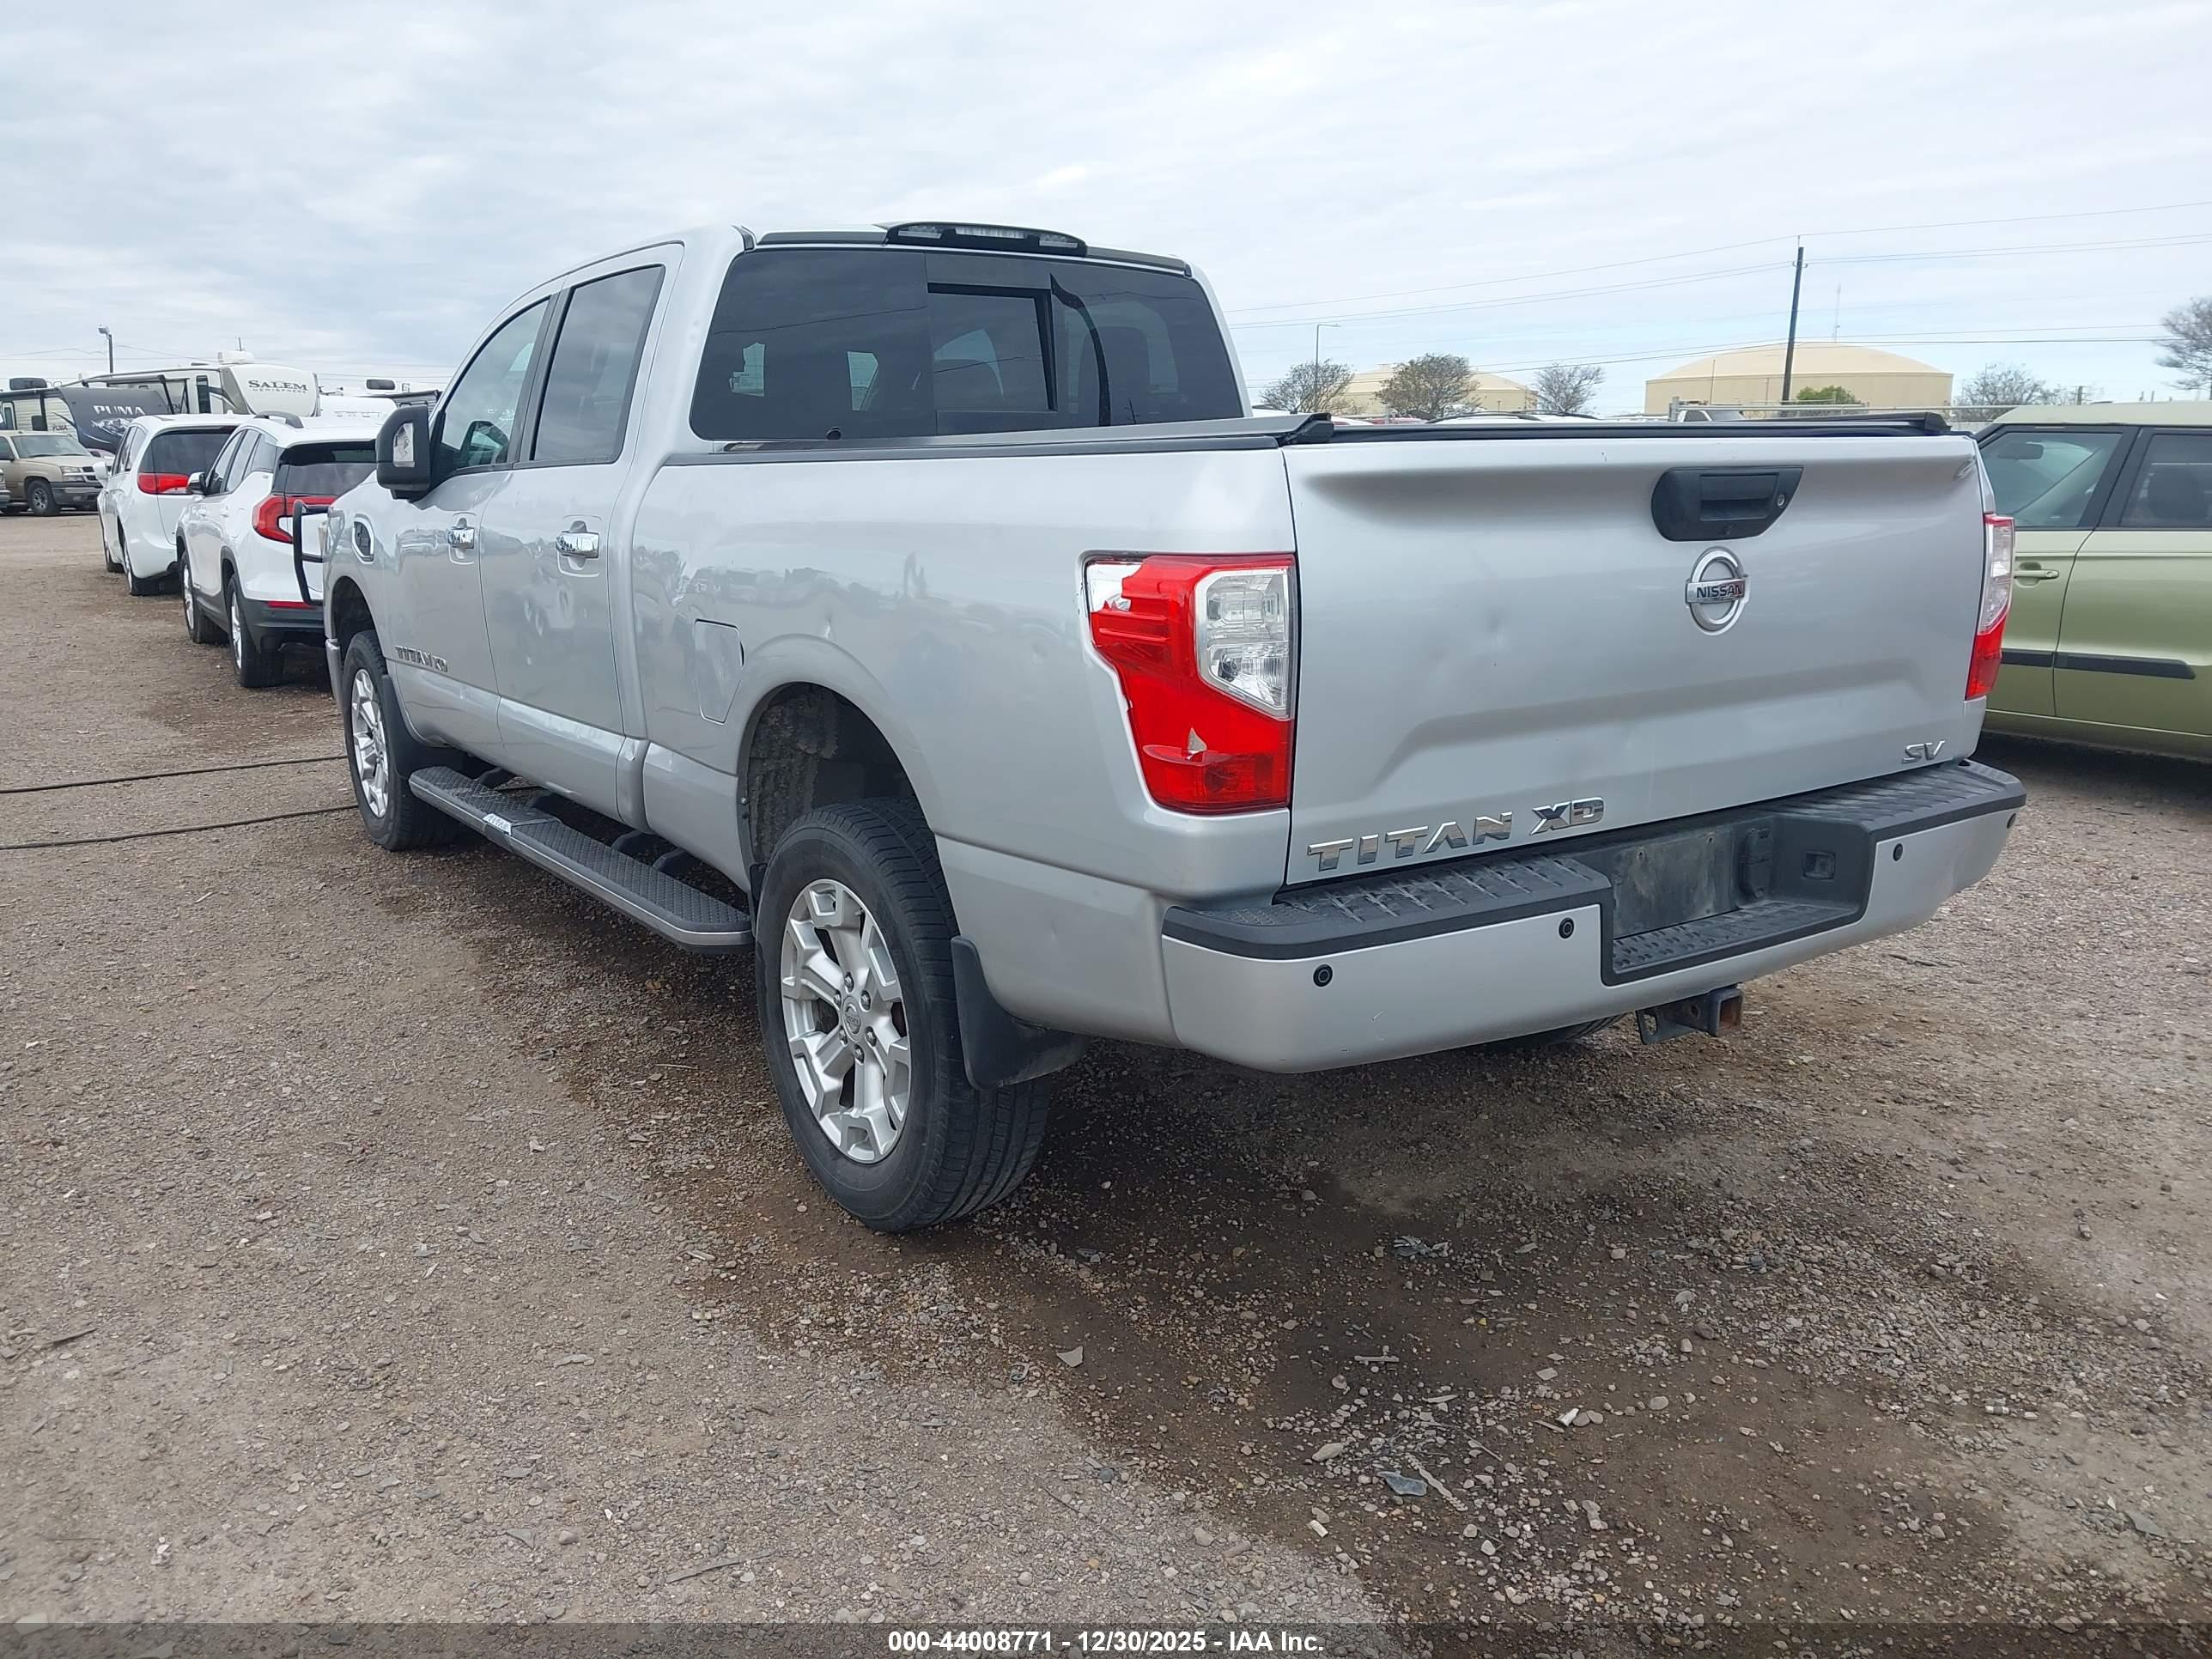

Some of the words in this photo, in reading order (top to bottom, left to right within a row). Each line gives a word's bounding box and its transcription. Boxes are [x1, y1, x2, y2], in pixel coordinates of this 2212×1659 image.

[247, 379, 309, 392] SALEM
[93, 404, 146, 415] PUMA
[1696, 583, 1744, 599] NISSAN
[395, 645, 433, 667] TITAN
[1901, 739, 1947, 764] SV
[1307, 811, 1514, 872] TITAN
[1529, 795, 1607, 836] XD
